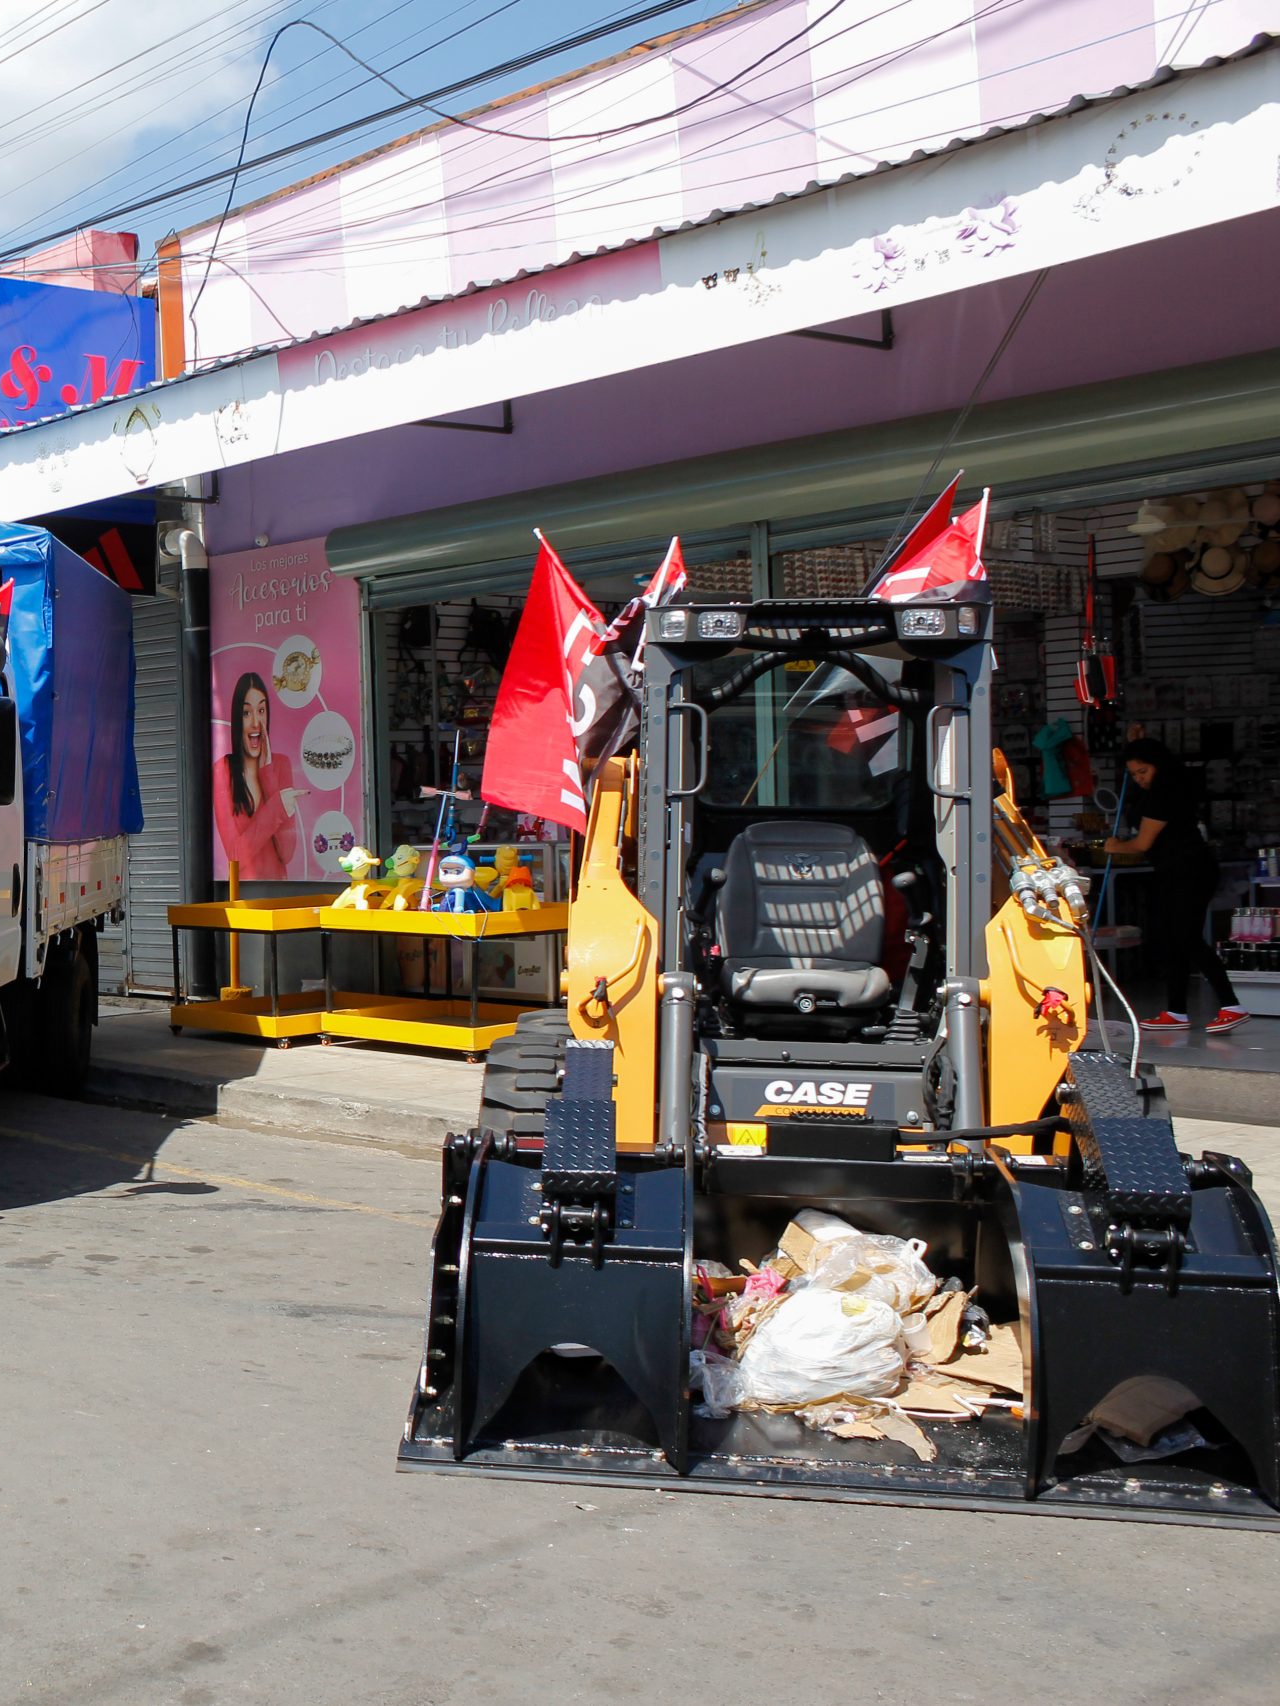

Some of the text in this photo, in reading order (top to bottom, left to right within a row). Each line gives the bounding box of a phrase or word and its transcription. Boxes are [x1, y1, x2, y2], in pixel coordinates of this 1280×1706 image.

[0, 345, 52, 411] &
[61, 353, 144, 405] M
[251, 553, 308, 572] Los mejores
[229, 569, 334, 611] Accesorios
[255, 601, 307, 633] para ti
[764, 1080, 873, 1105] CASE
